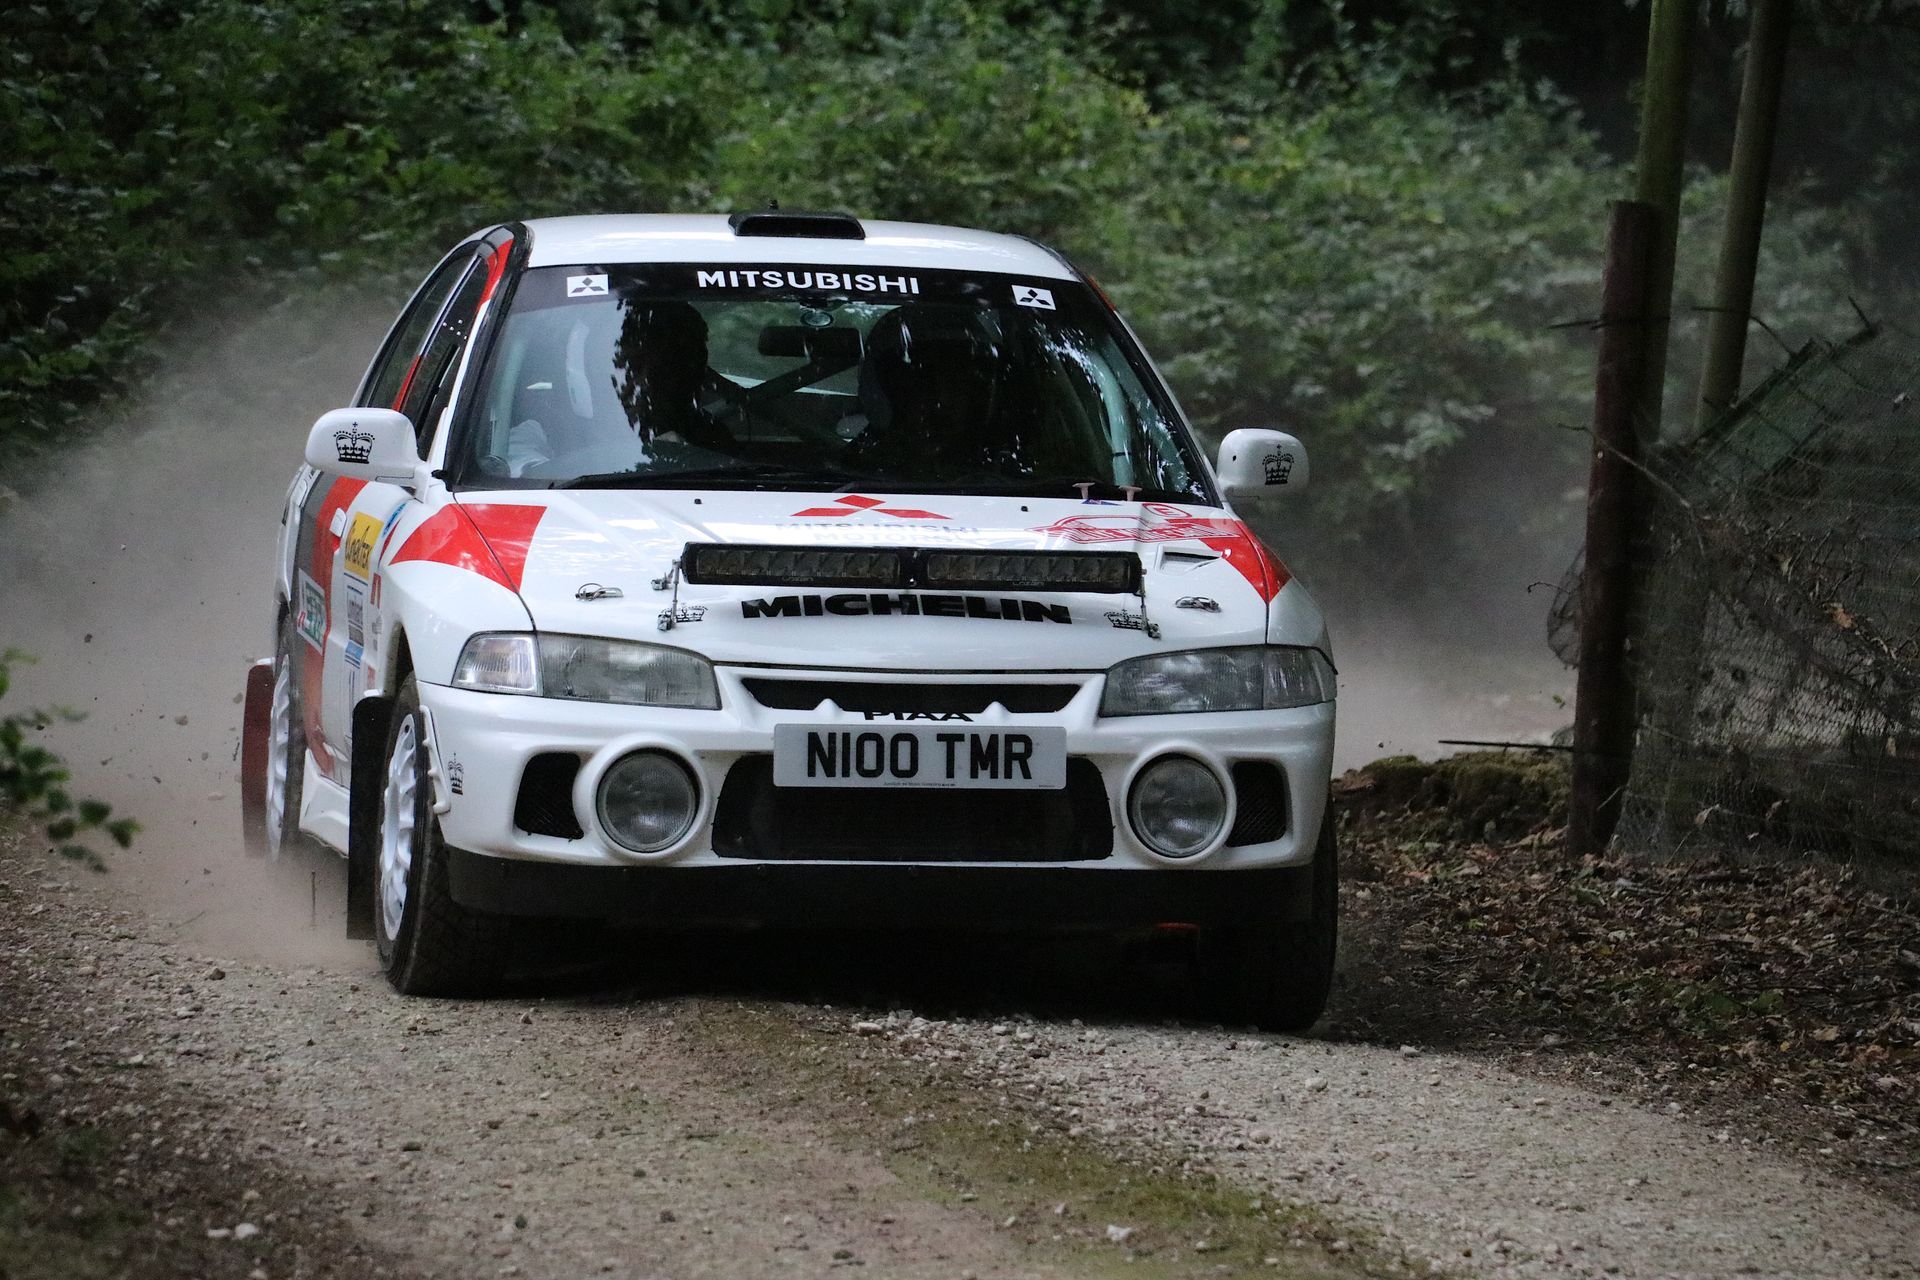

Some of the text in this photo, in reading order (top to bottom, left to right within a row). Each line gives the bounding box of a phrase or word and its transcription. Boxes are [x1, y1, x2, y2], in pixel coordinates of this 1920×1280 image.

[697, 270, 920, 294] MITSUBISHI
[741, 594, 1073, 625] MICHELIN
[807, 732, 1033, 780] N100 TMR
